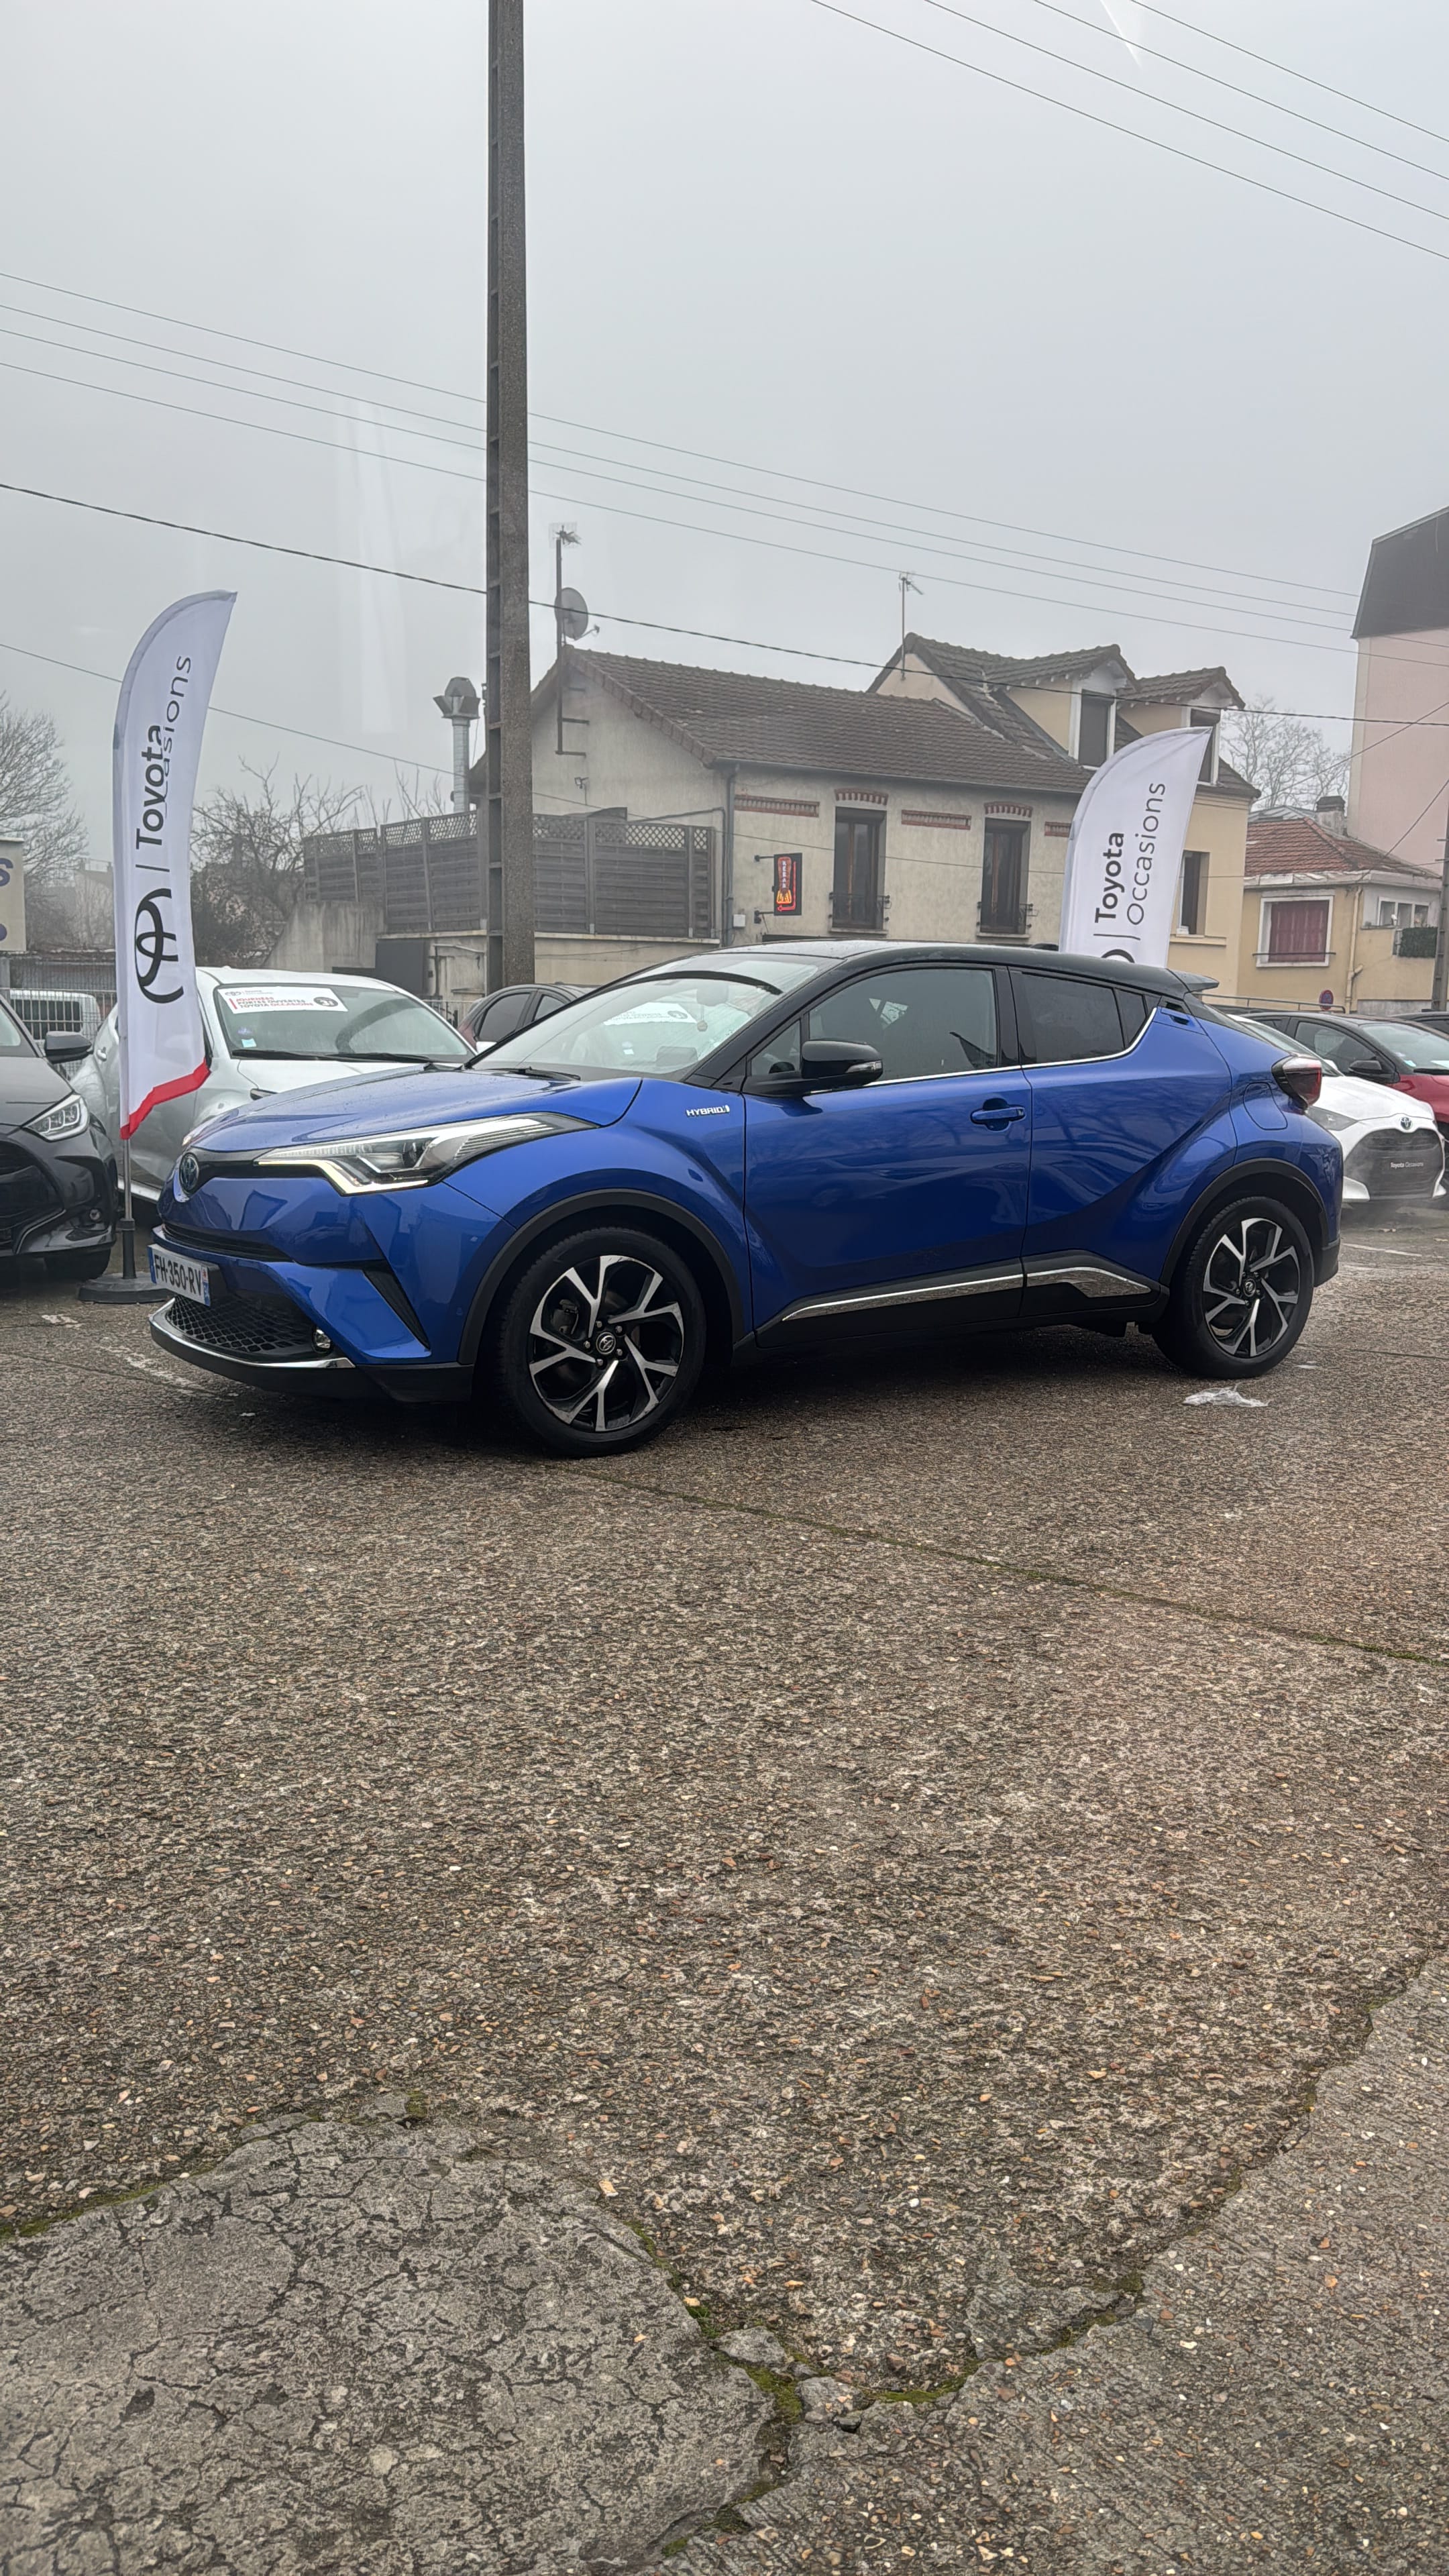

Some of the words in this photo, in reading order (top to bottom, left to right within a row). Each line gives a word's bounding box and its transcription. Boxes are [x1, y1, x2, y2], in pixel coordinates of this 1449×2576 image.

[136, 725, 165, 850] Toyota
[1094, 832, 1125, 923] Toyota
[1127, 783, 1166, 926] Occasions
[686, 1106, 724, 1116] HYBRID
[154, 1254, 201, 1296] FH-350-RV
